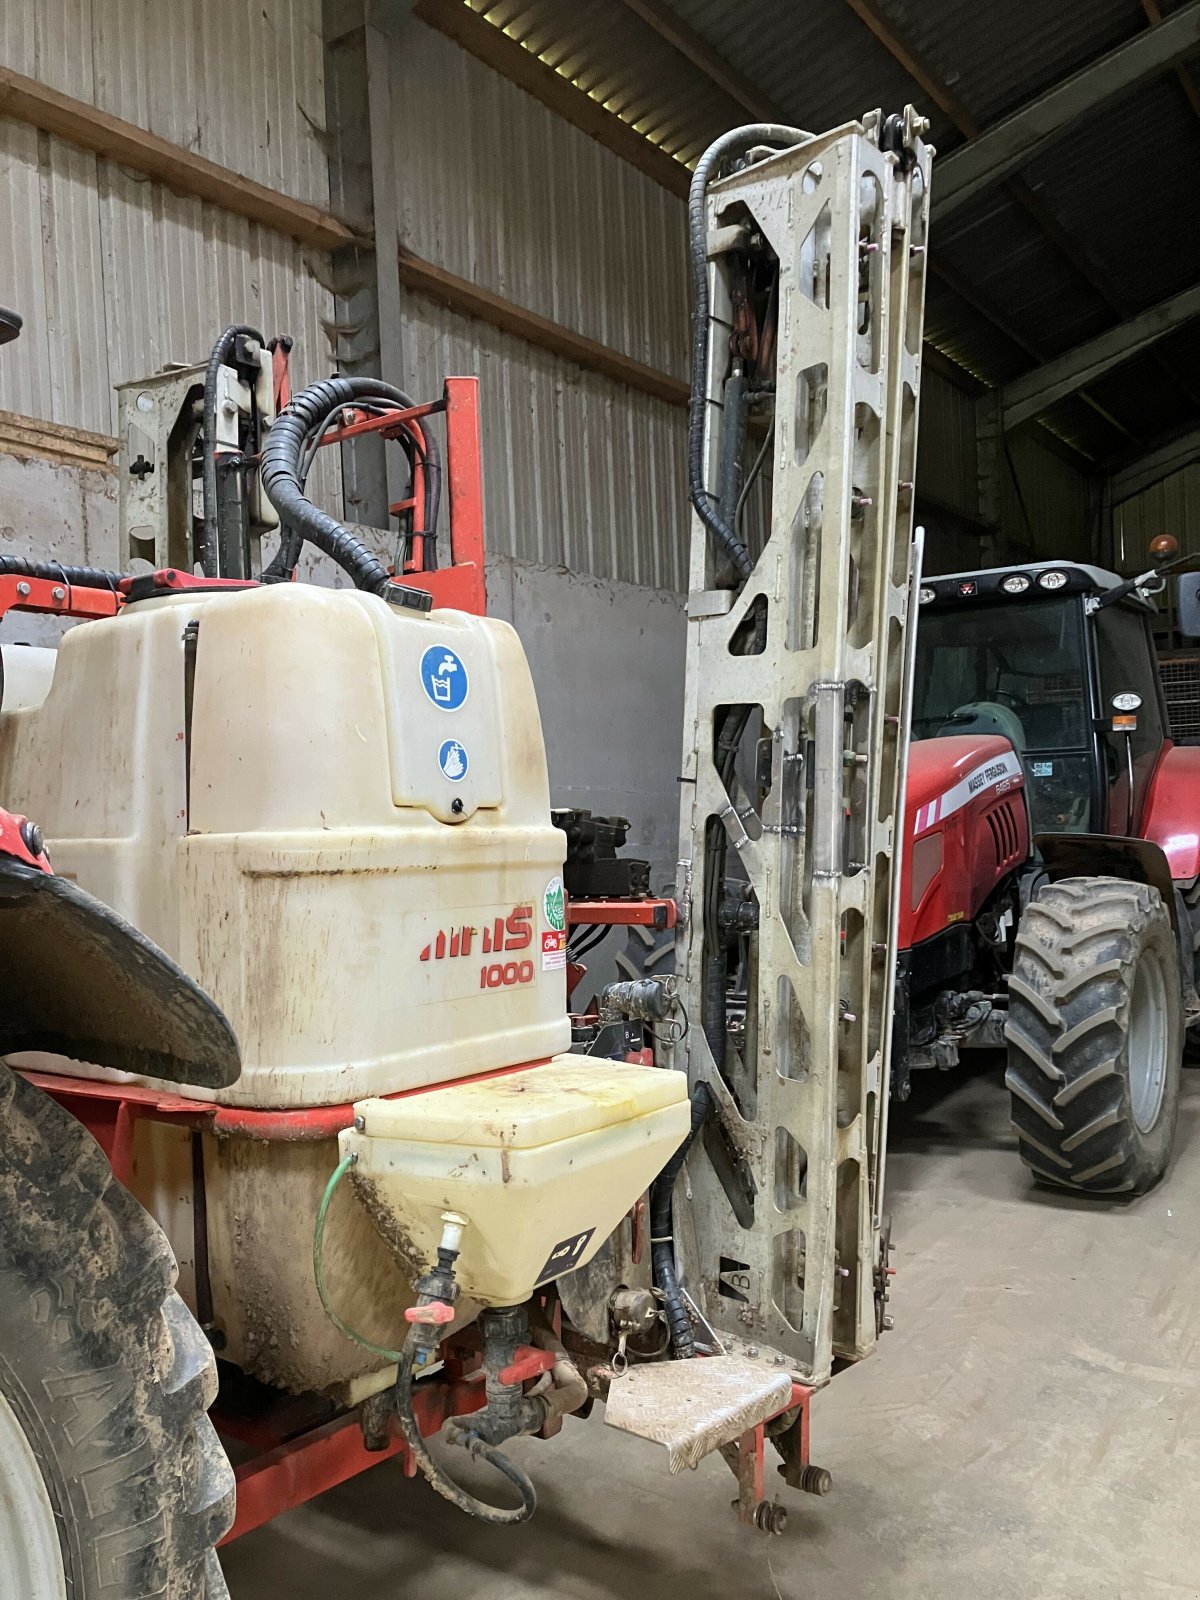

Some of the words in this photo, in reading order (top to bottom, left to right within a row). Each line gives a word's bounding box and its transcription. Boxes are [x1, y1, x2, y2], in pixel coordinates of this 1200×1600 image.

[968, 772, 987, 794] MASSEY
[984, 762, 1008, 781] FERGUSON
[480, 960, 534, 988] 1000
